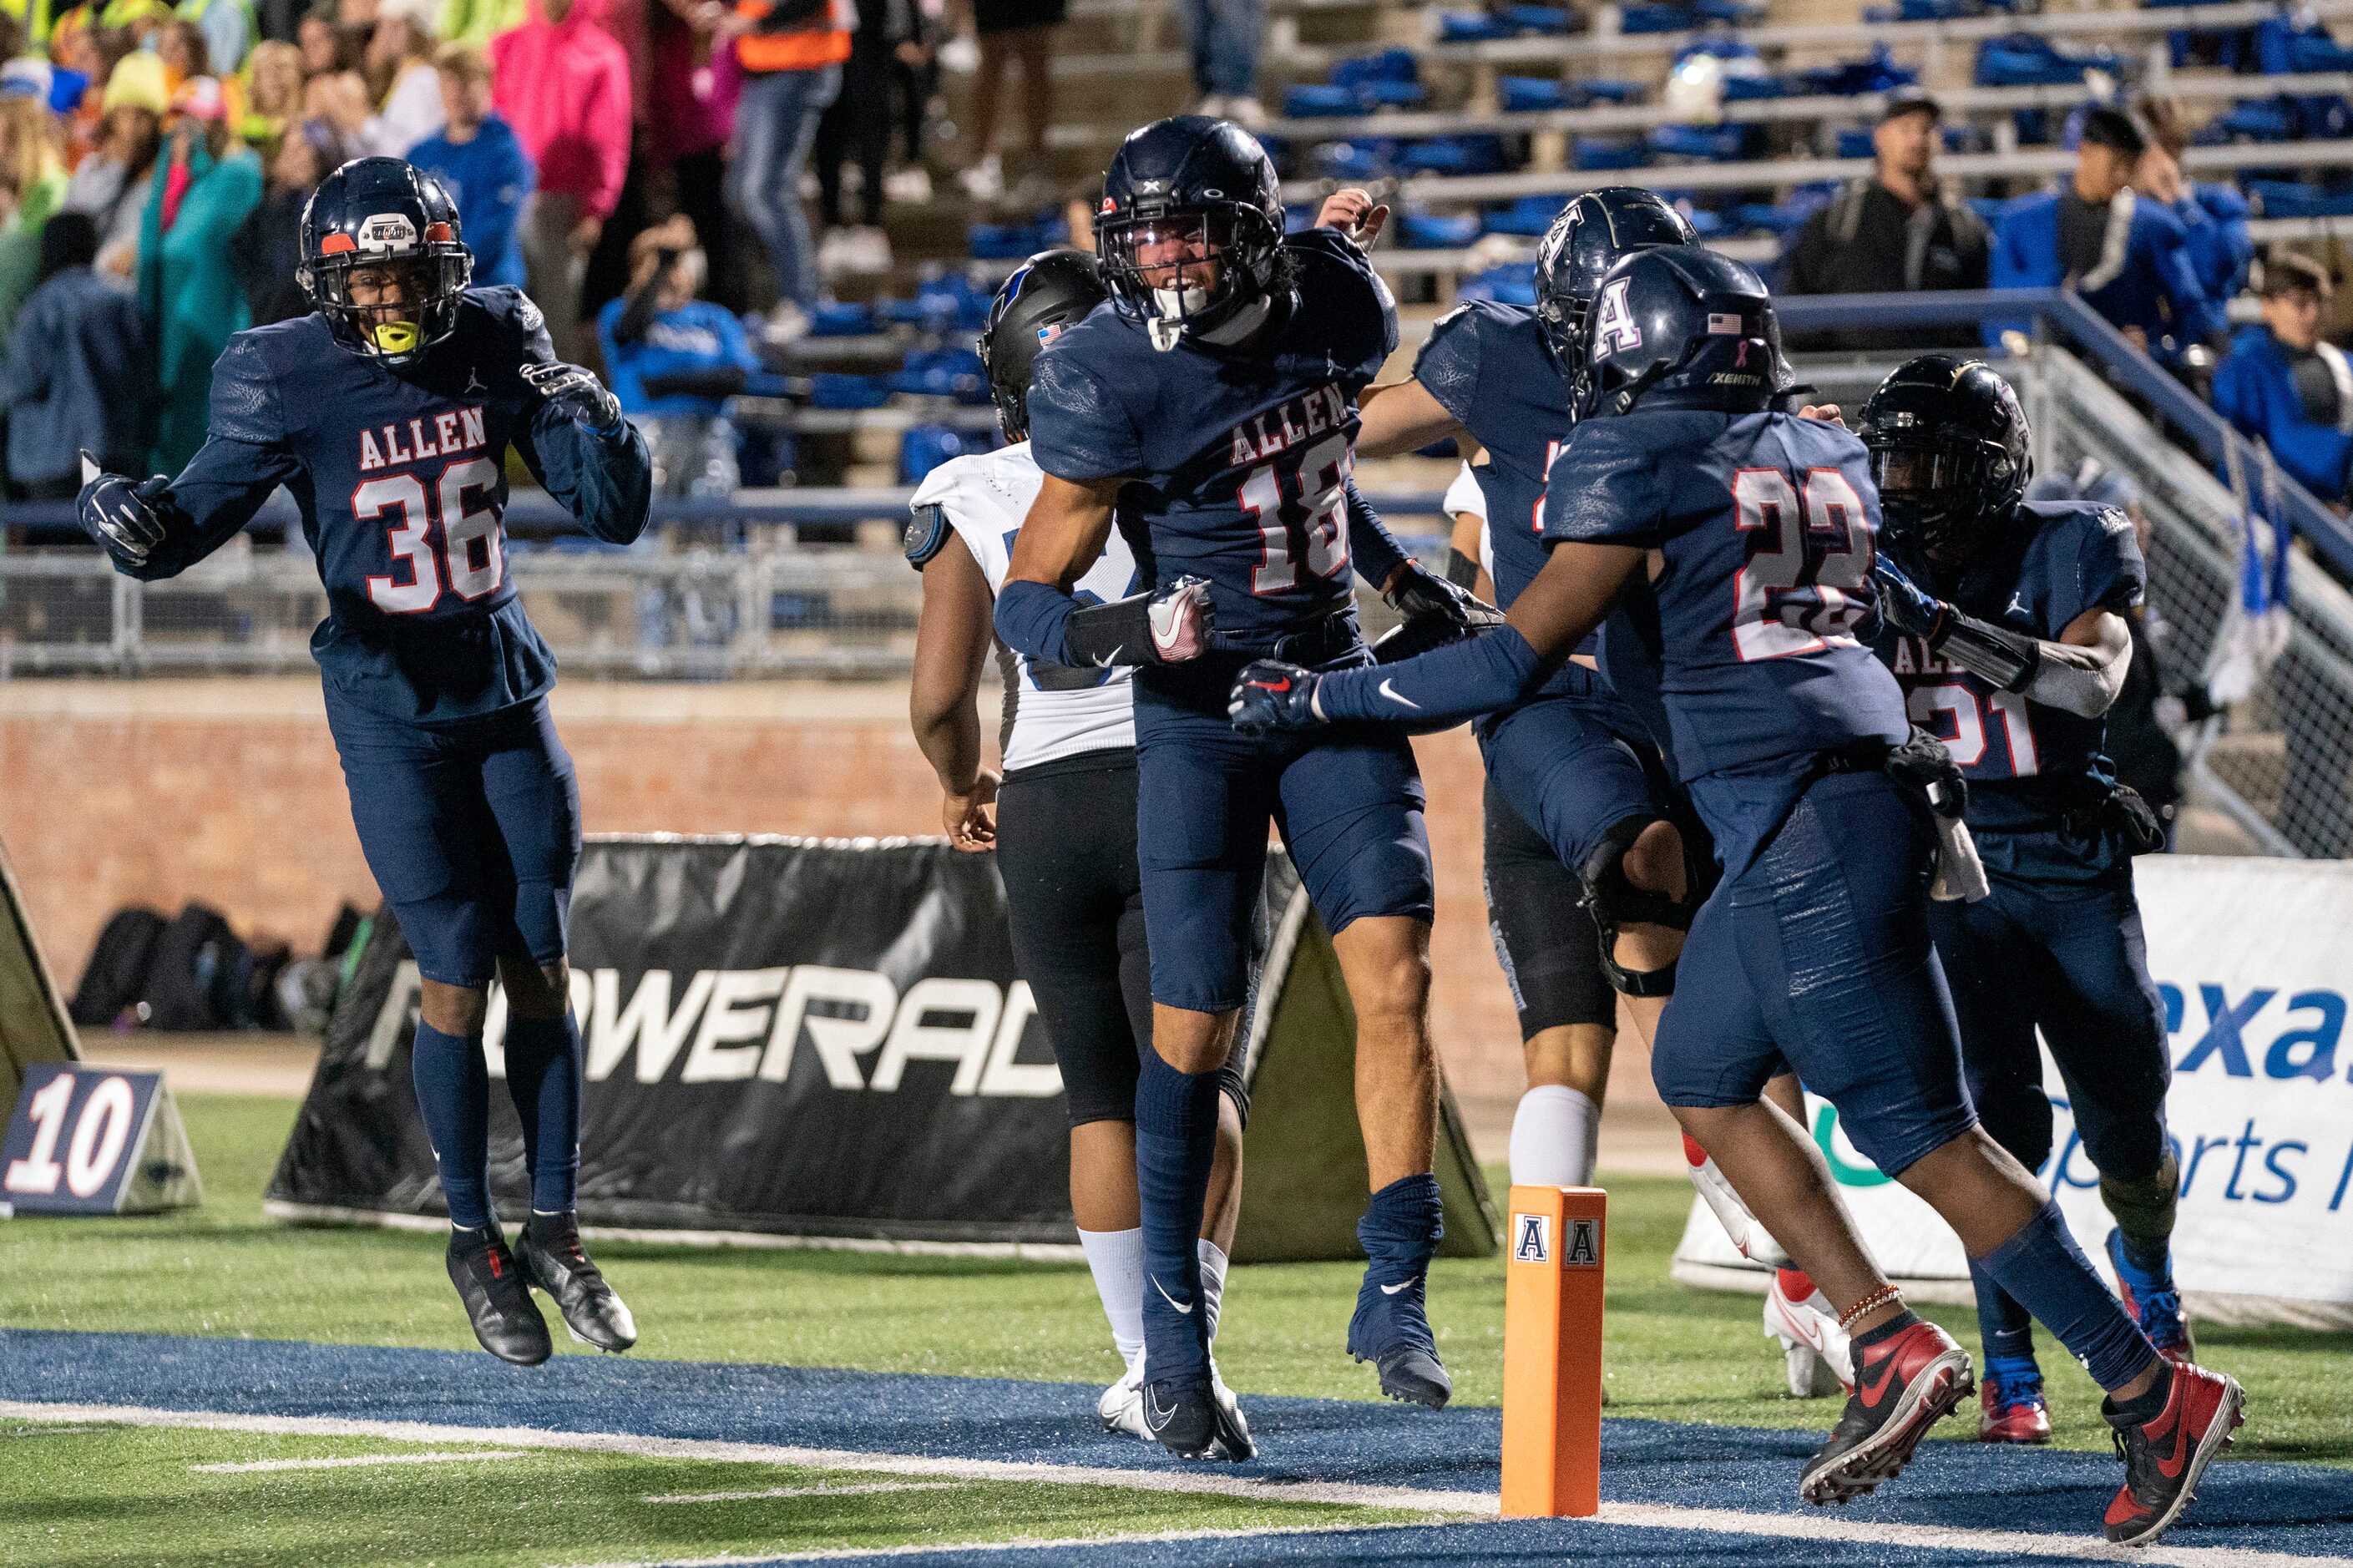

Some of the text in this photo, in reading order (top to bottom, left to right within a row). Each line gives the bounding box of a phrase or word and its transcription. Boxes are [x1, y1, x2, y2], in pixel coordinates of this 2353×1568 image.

[1537, 204, 1584, 282] A
[1594, 276, 1642, 363] A
[1713, 372, 1762, 387] XENITH
[360, 404, 486, 470] ALLEN
[1231, 381, 1349, 466] ALLEN
[351, 456, 503, 615] 36
[1236, 431, 1353, 596] 18
[1731, 467, 1873, 661] 22
[4, 1072, 134, 1198] 10
[2037, 1095, 2308, 1204] prts
[1516, 1216, 1546, 1262] A
[1567, 1220, 1596, 1264] A
